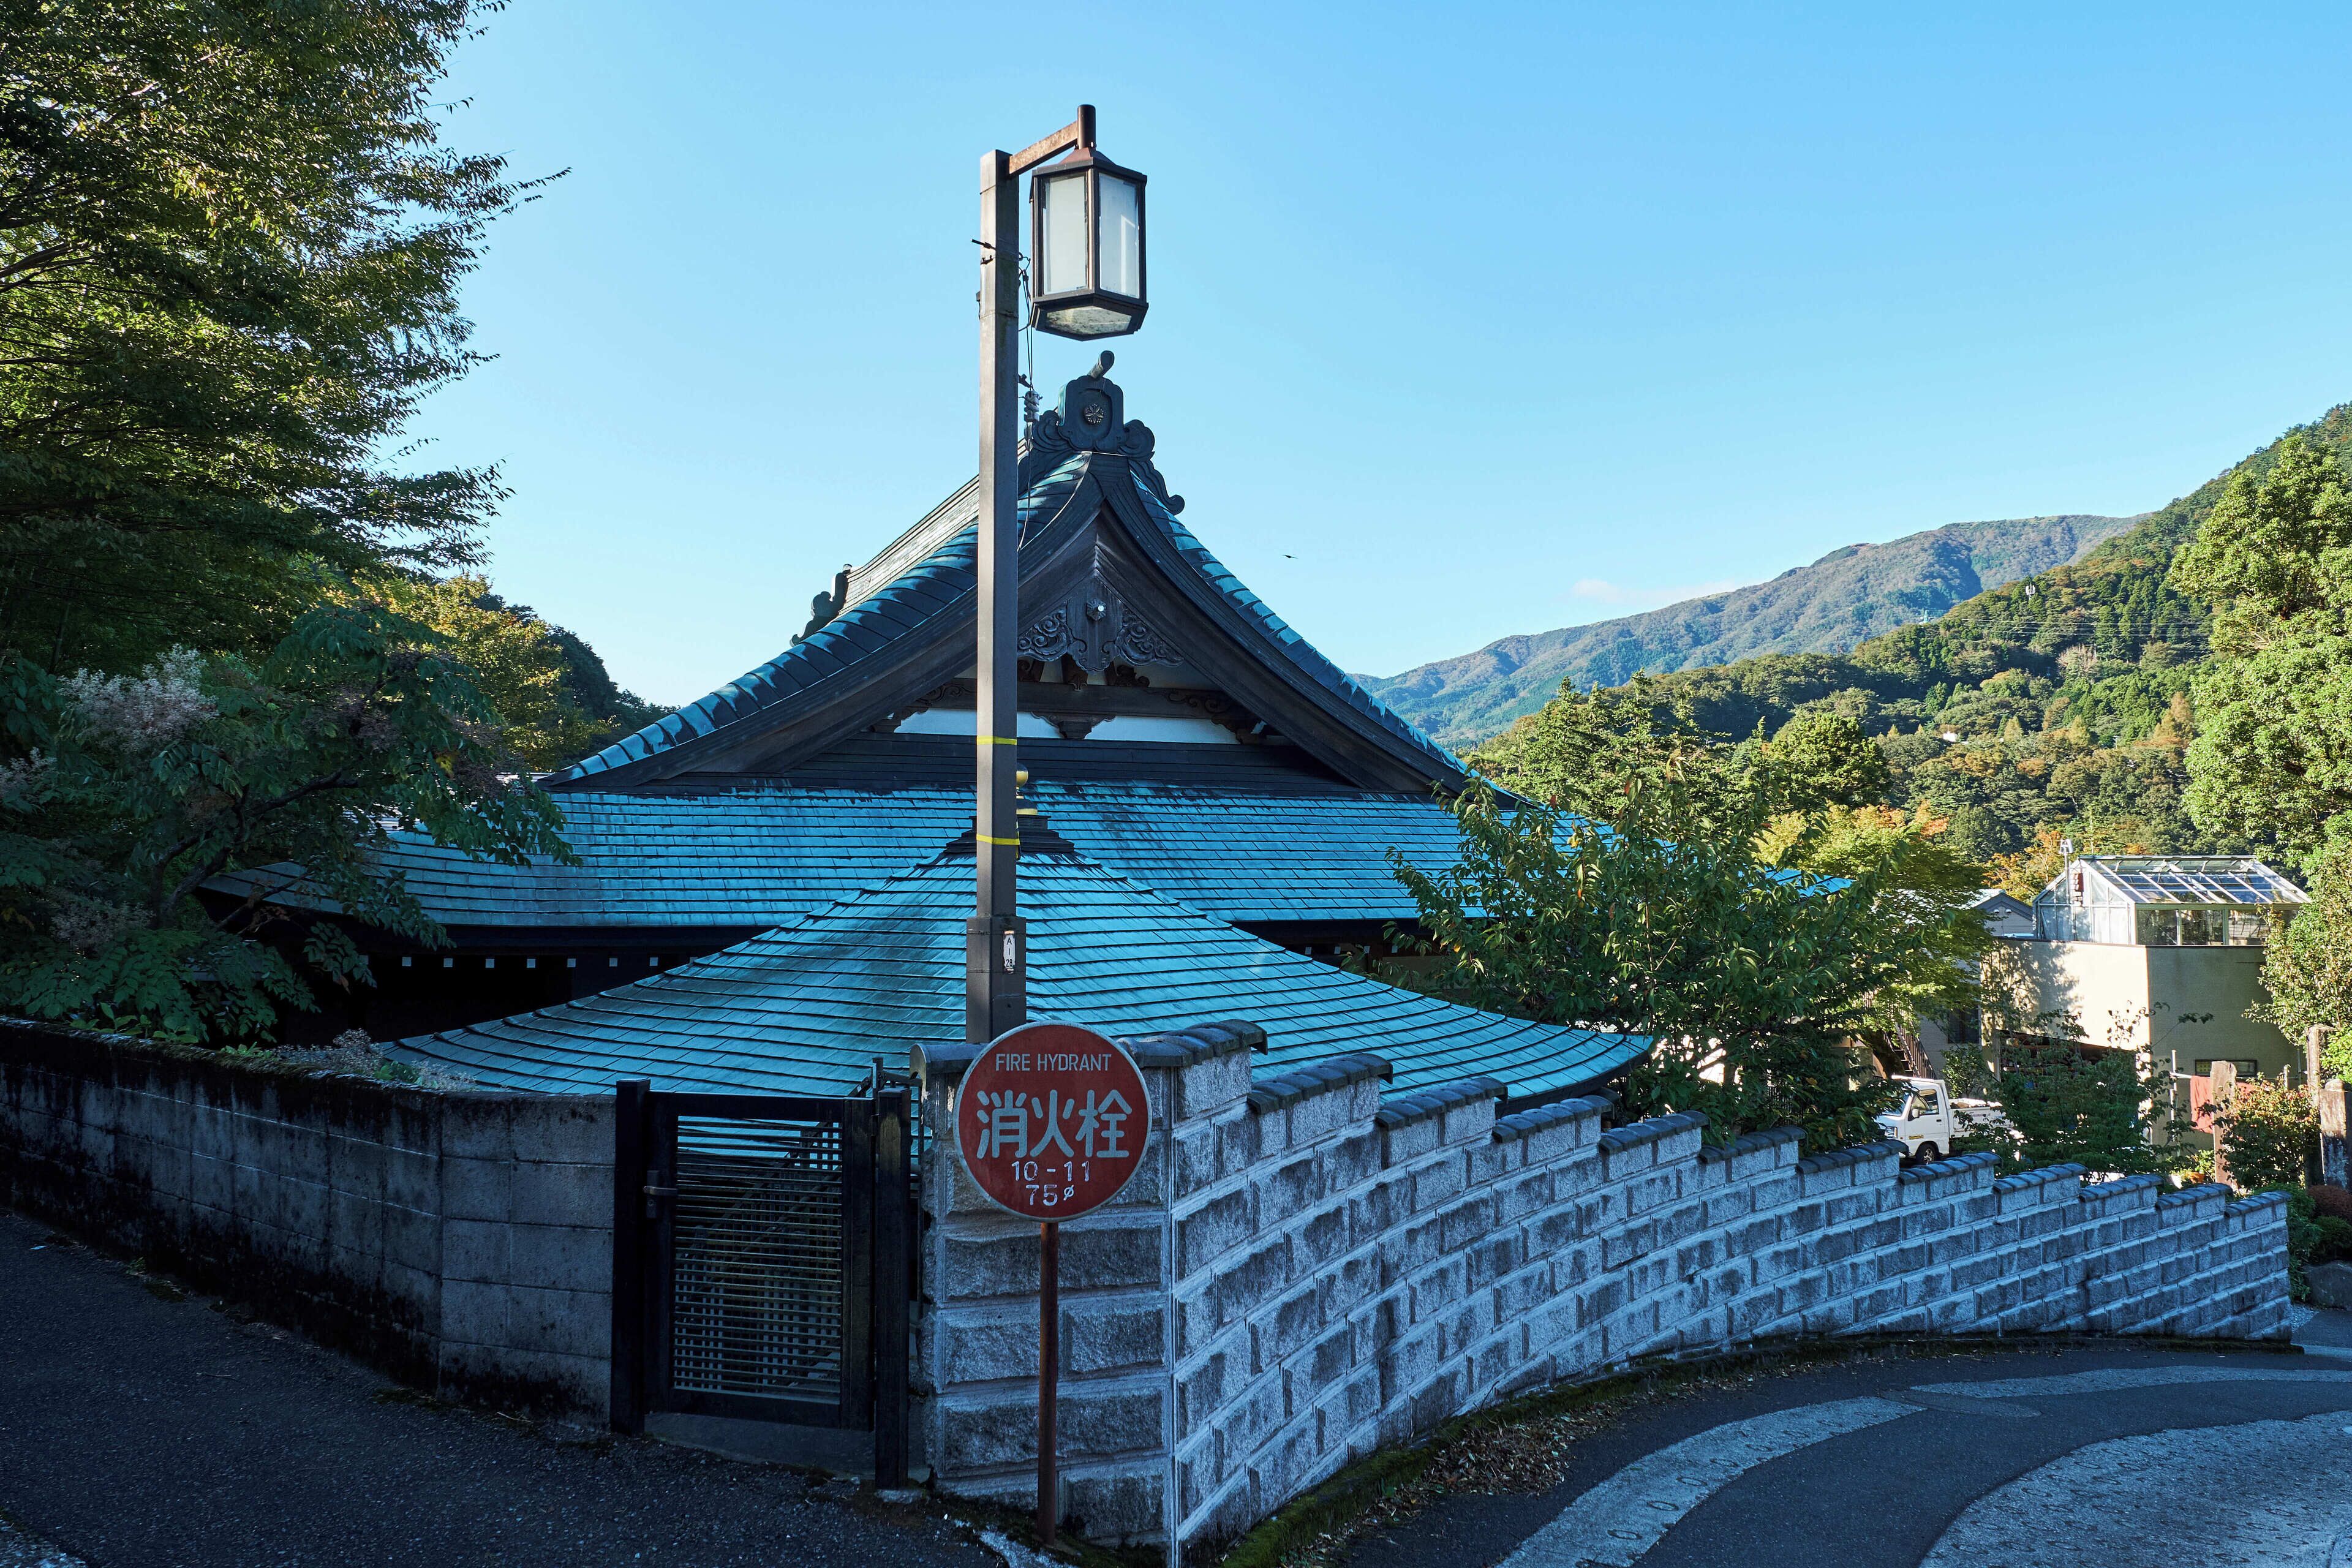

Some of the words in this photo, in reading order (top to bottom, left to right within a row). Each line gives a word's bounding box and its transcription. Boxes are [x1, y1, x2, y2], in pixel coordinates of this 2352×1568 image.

[1006, 959, 1013, 967] 28
[995, 1054, 1030, 1071] FIRE
[1038, 1054, 1112, 1071] HYDRANT
[976, 1089, 1133, 1159] 消火栓
